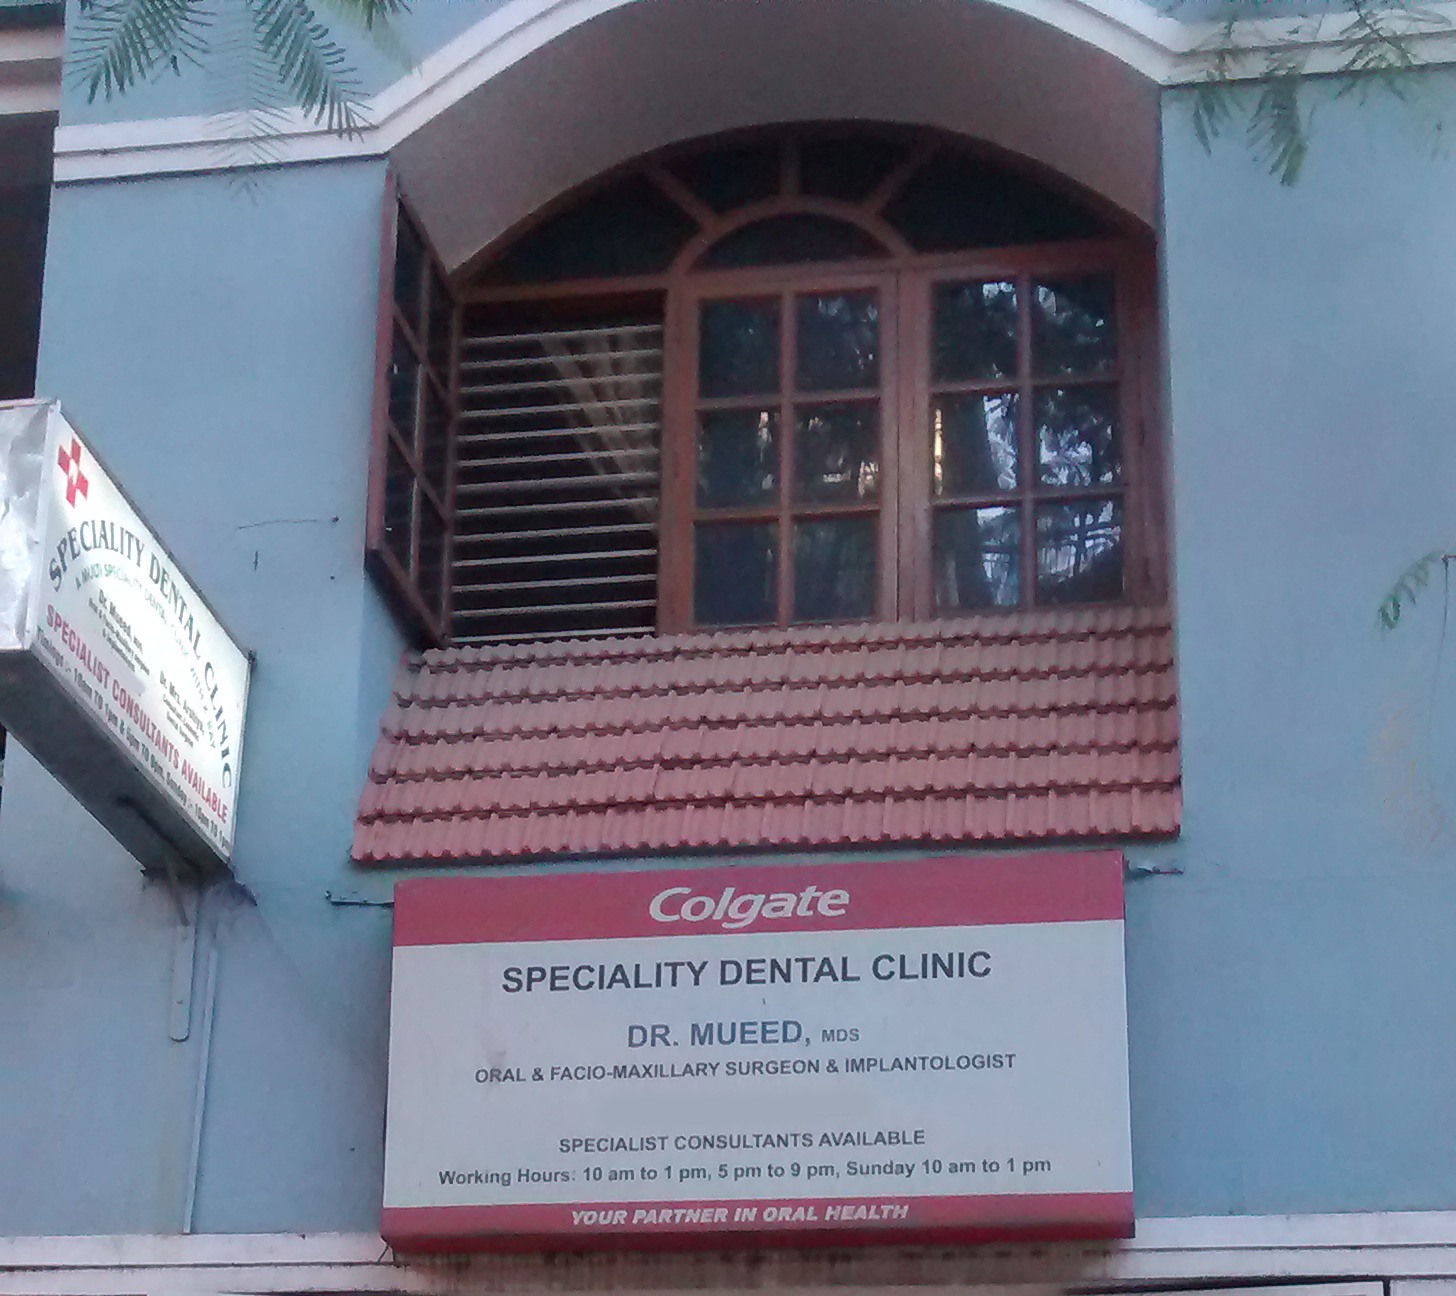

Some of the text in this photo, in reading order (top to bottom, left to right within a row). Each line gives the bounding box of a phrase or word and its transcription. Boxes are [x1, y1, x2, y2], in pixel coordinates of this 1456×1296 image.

[49, 520, 232, 788] SPECIALITY DENTAL CLINIC
[47, 604, 229, 824] SPECIALIST CONSULTANTS AVAILABLE
[648, 885, 850, 929] Colgate
[502, 950, 992, 993] SPECIALITY DENTAL CLINIC
[627, 1020, 860, 1048] DR. MUEED, MDS
[475, 1053, 1016, 1084] ORAL & FACIO-MAXILLARY SURGEON & IMPLANTOLOGIST
[559, 1130, 926, 1153] SPECIALIST CONSULTANTS AVAILABLE
[438, 1158, 1052, 1187] Working Hours: 10 am to 1 pm, 5 pm to 9 pm, Sunday 10 am to 1 pm
[572, 1204, 909, 1225] YOUR PARTNER IN ORAL HEALTH
